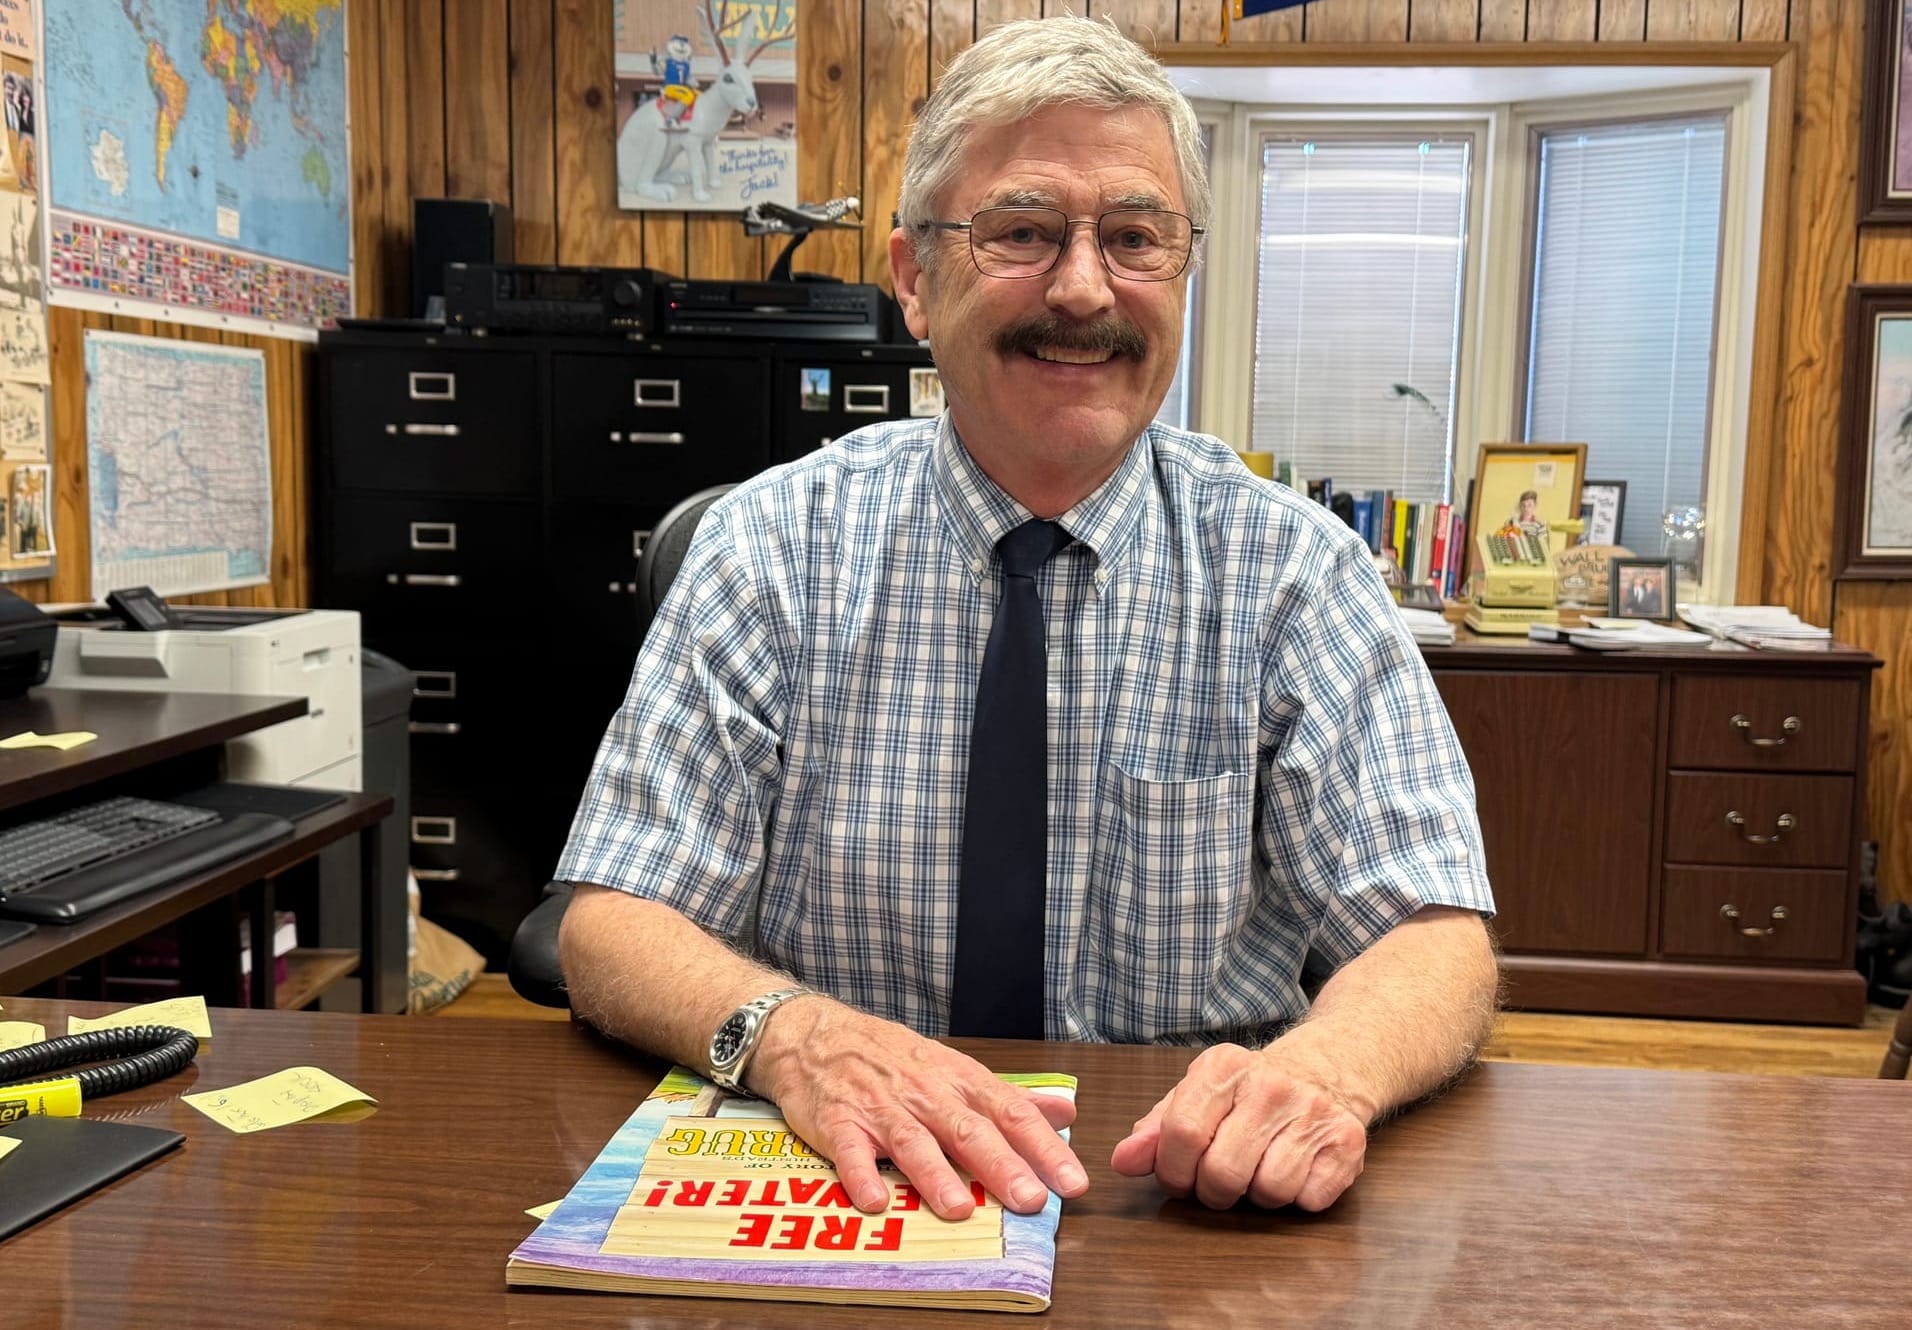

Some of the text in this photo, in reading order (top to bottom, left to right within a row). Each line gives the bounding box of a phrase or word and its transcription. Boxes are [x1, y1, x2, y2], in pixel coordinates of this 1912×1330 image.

[0, 1105, 25, 1122] er
[782, 1163, 837, 1171] TORY
[728, 1213, 904, 1251] FREE
